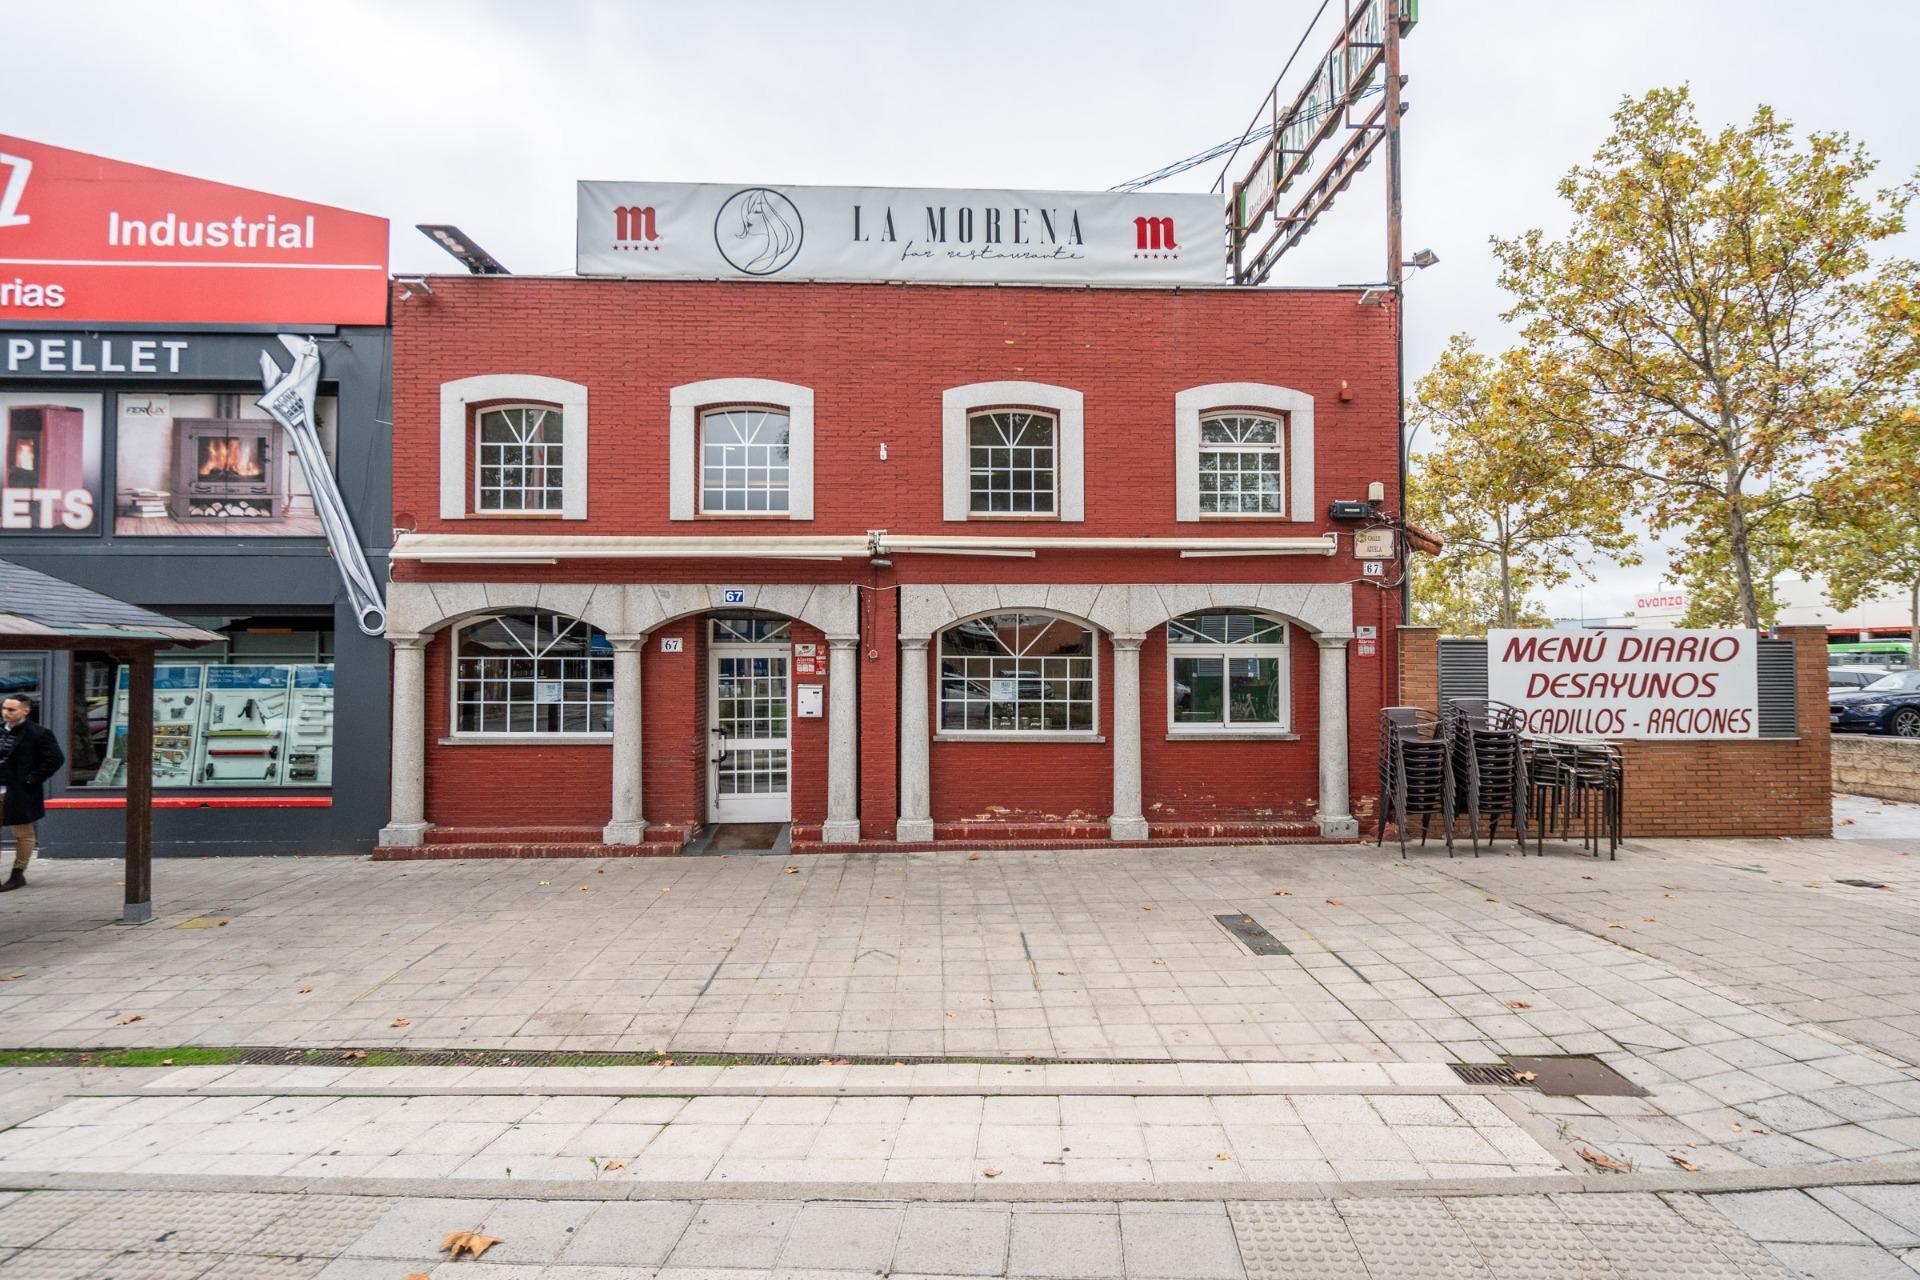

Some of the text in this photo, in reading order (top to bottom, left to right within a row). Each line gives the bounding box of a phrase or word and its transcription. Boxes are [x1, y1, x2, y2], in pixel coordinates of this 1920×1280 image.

[109, 211, 314, 249] Industrial
[853, 205, 1084, 245] LA MORENA
[947, 245, 1085, 260] restaurante
[8, 338, 189, 373] PELLET
[2, 487, 94, 530] ETS
[1366, 564, 1379, 574] 67
[726, 591, 743, 602] 67
[1637, 596, 1683, 608] avanza
[664, 640, 679, 650] 67
[1502, 631, 1740, 662] MENÚ DIARIO
[1526, 673, 1719, 698] DESAYUNOS
[1647, 708, 1752, 734] RACIONES
